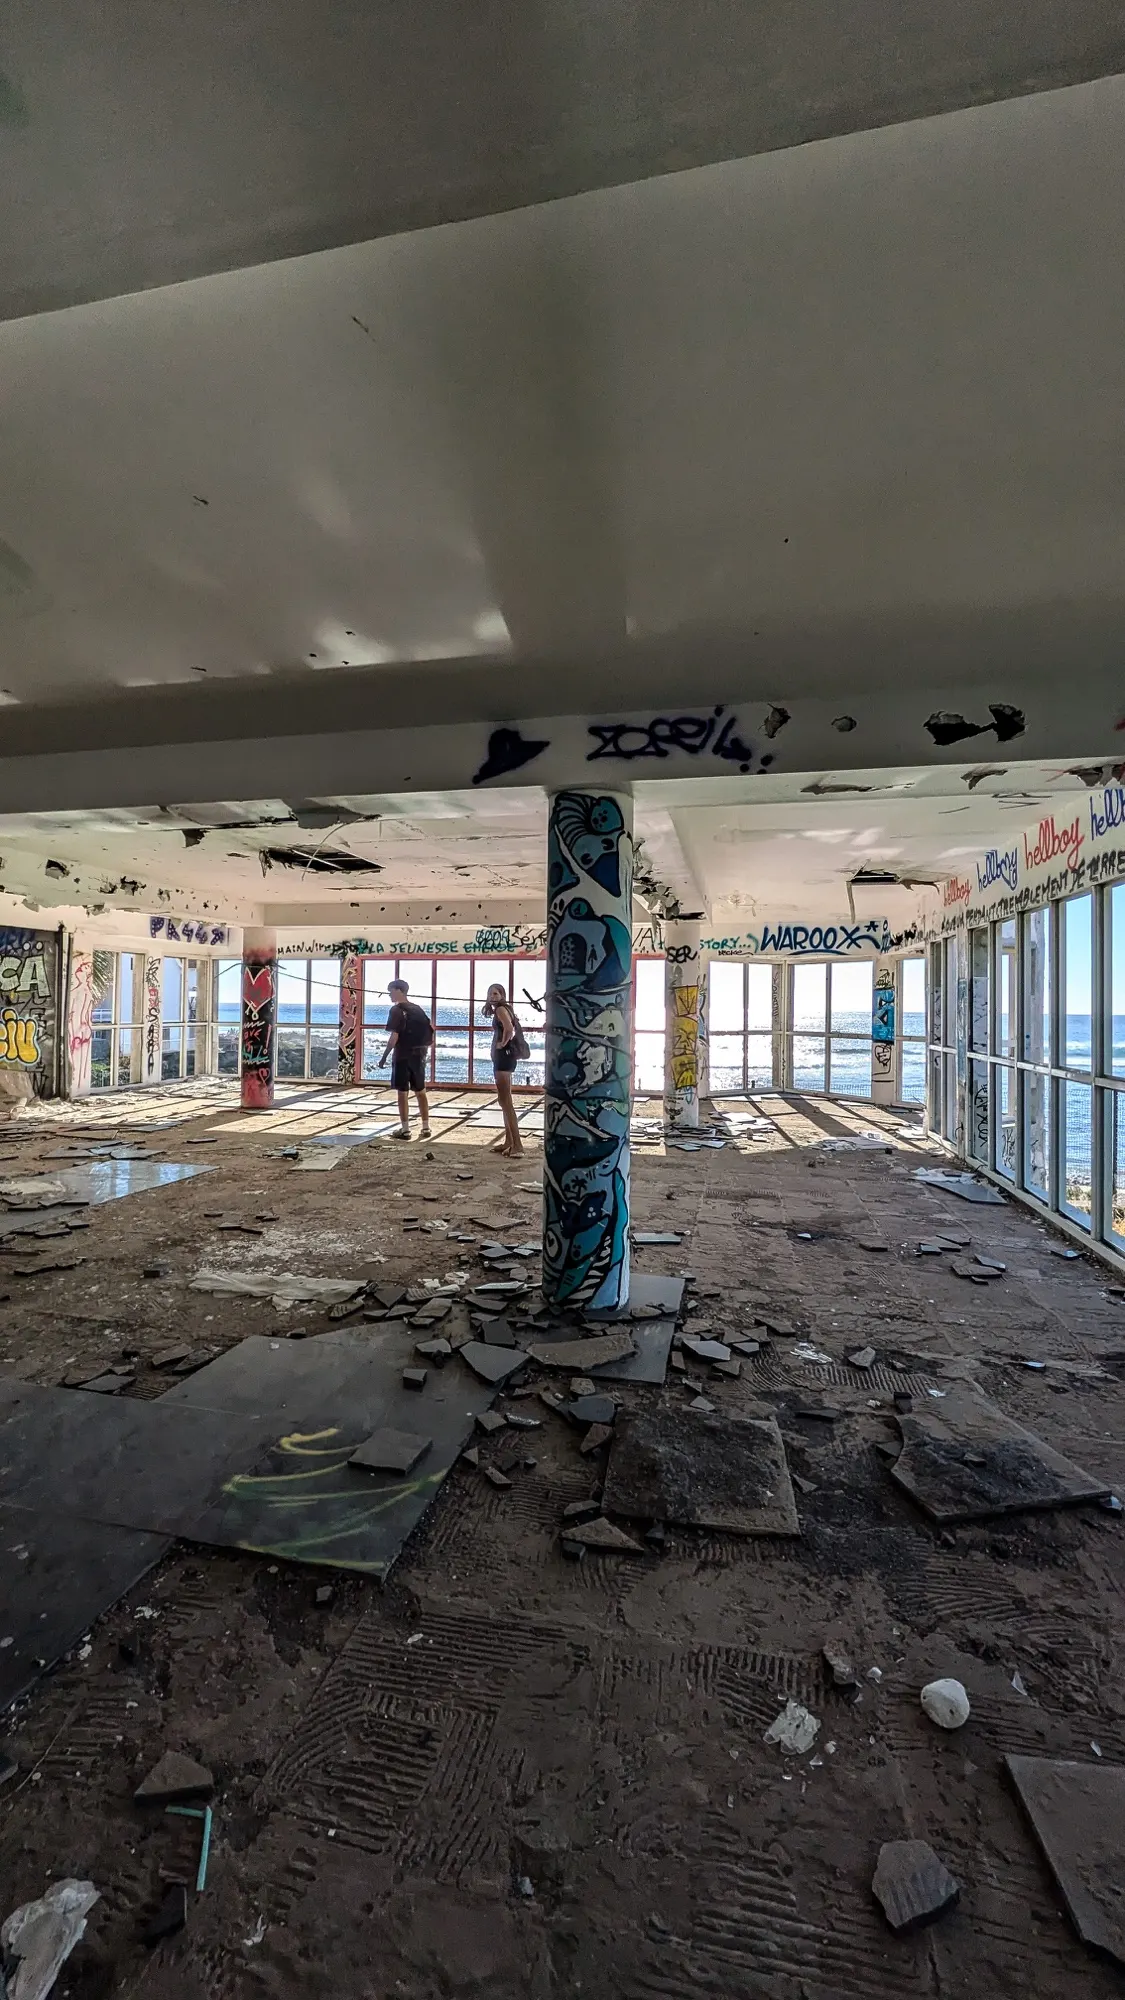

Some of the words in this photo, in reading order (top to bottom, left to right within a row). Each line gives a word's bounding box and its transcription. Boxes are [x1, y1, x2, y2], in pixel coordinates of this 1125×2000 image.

[1024, 817, 1085, 870] hellboy
[943, 876, 972, 907] hellboy
[390, 941, 459, 954] JEUNESSE
